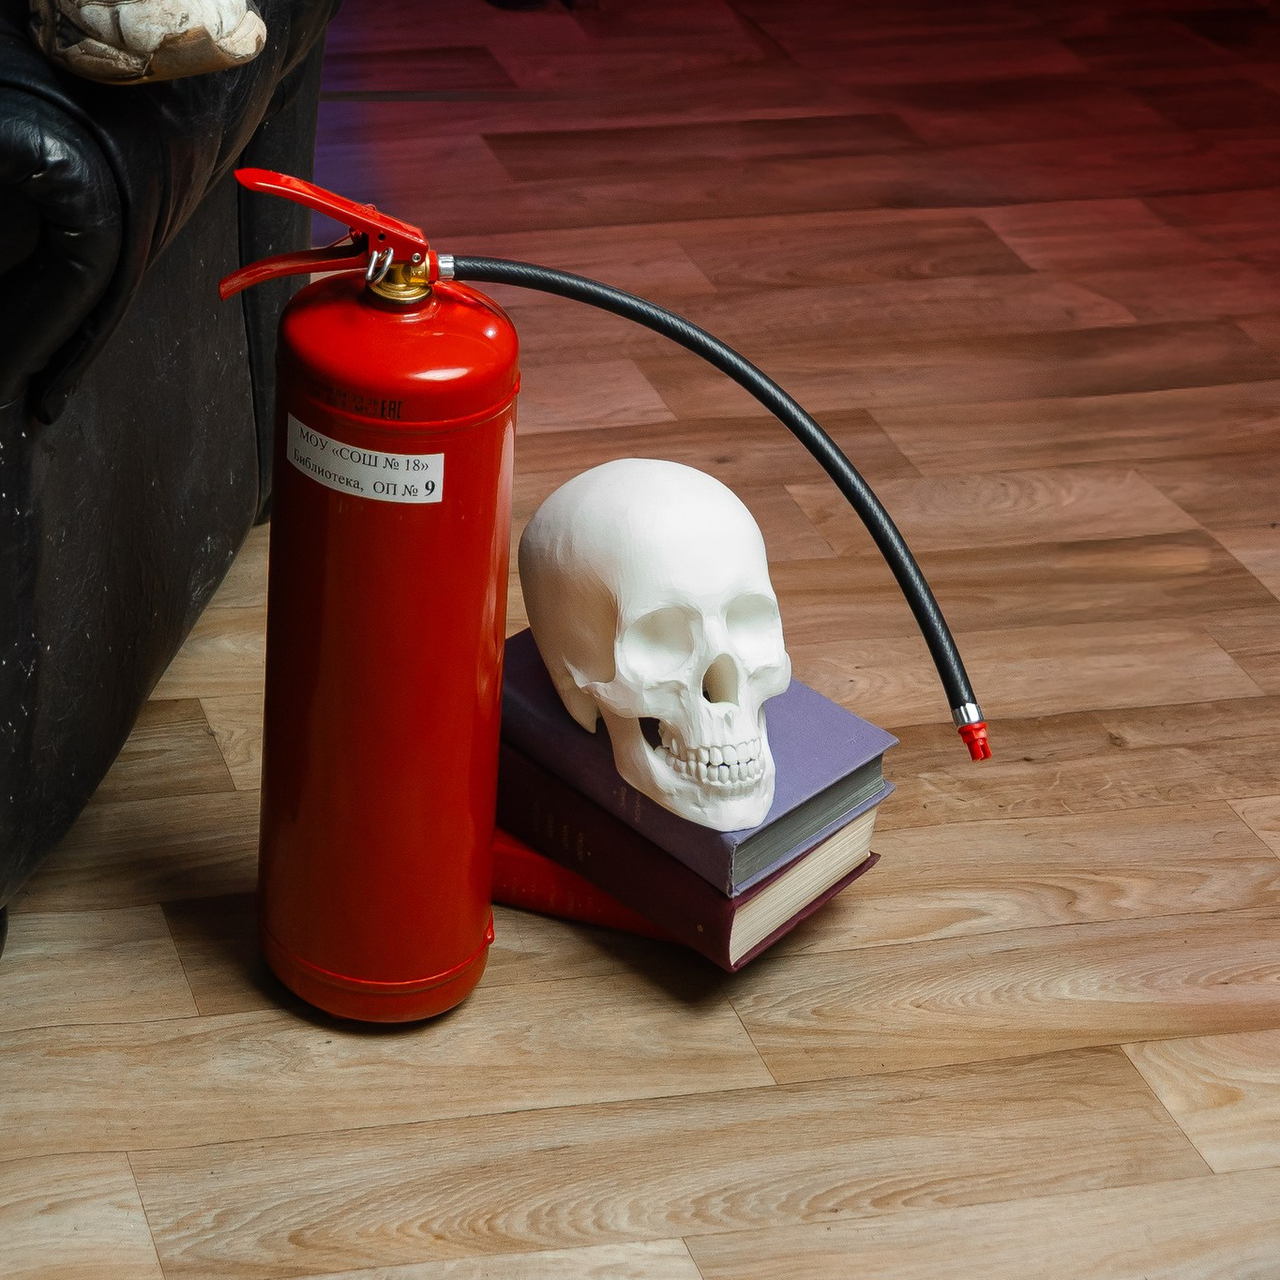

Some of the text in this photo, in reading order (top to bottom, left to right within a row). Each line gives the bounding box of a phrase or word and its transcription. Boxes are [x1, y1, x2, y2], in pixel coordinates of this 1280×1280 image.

[292, 447, 436, 497] Библиотека, ОП № 9
[298, 425, 430, 471] МОУ «СОШ № 18»
